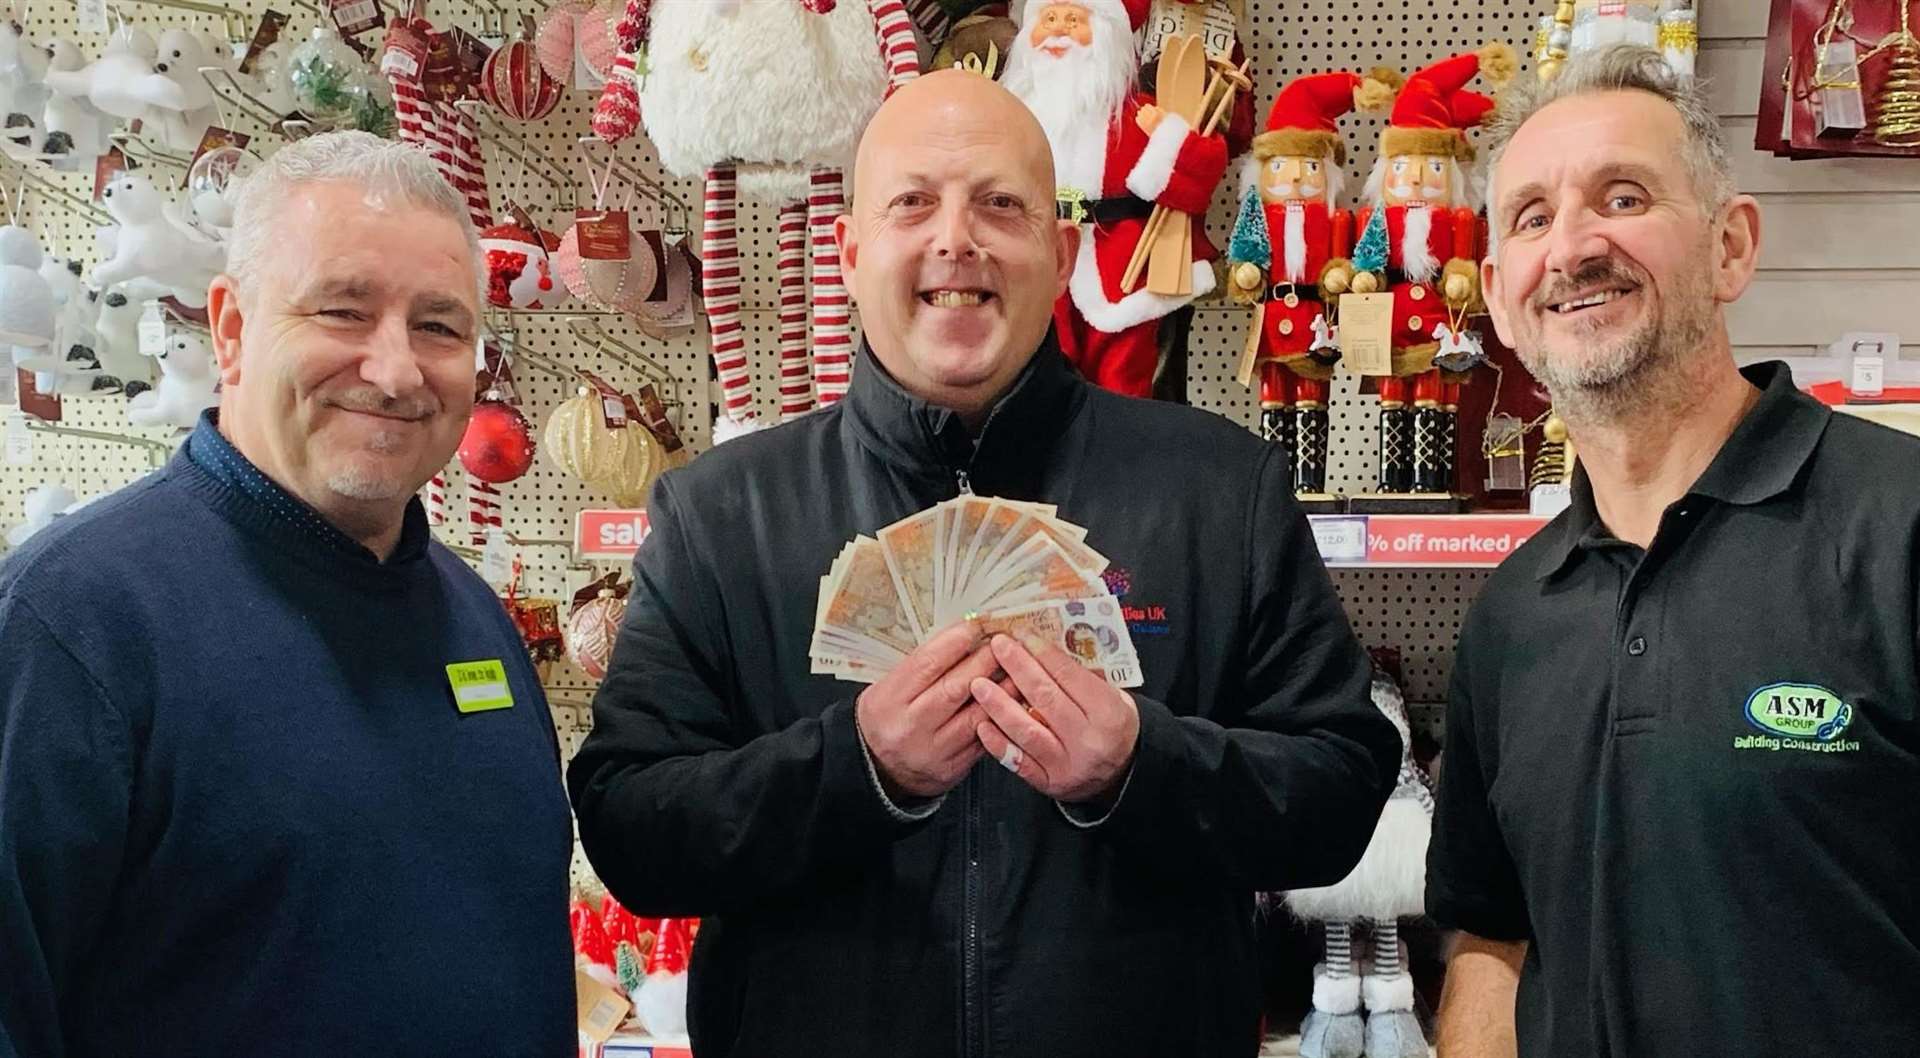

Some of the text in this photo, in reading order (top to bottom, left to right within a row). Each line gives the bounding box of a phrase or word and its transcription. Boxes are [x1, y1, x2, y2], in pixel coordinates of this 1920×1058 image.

[1393, 533, 1424, 551] off
[1427, 533, 1511, 551] marked
[1147, 606, 1166, 620] UK
[1767, 695, 1826, 718] ASM
[1775, 717, 1816, 729] GROUP
[1734, 735, 1860, 752] Building Construction
